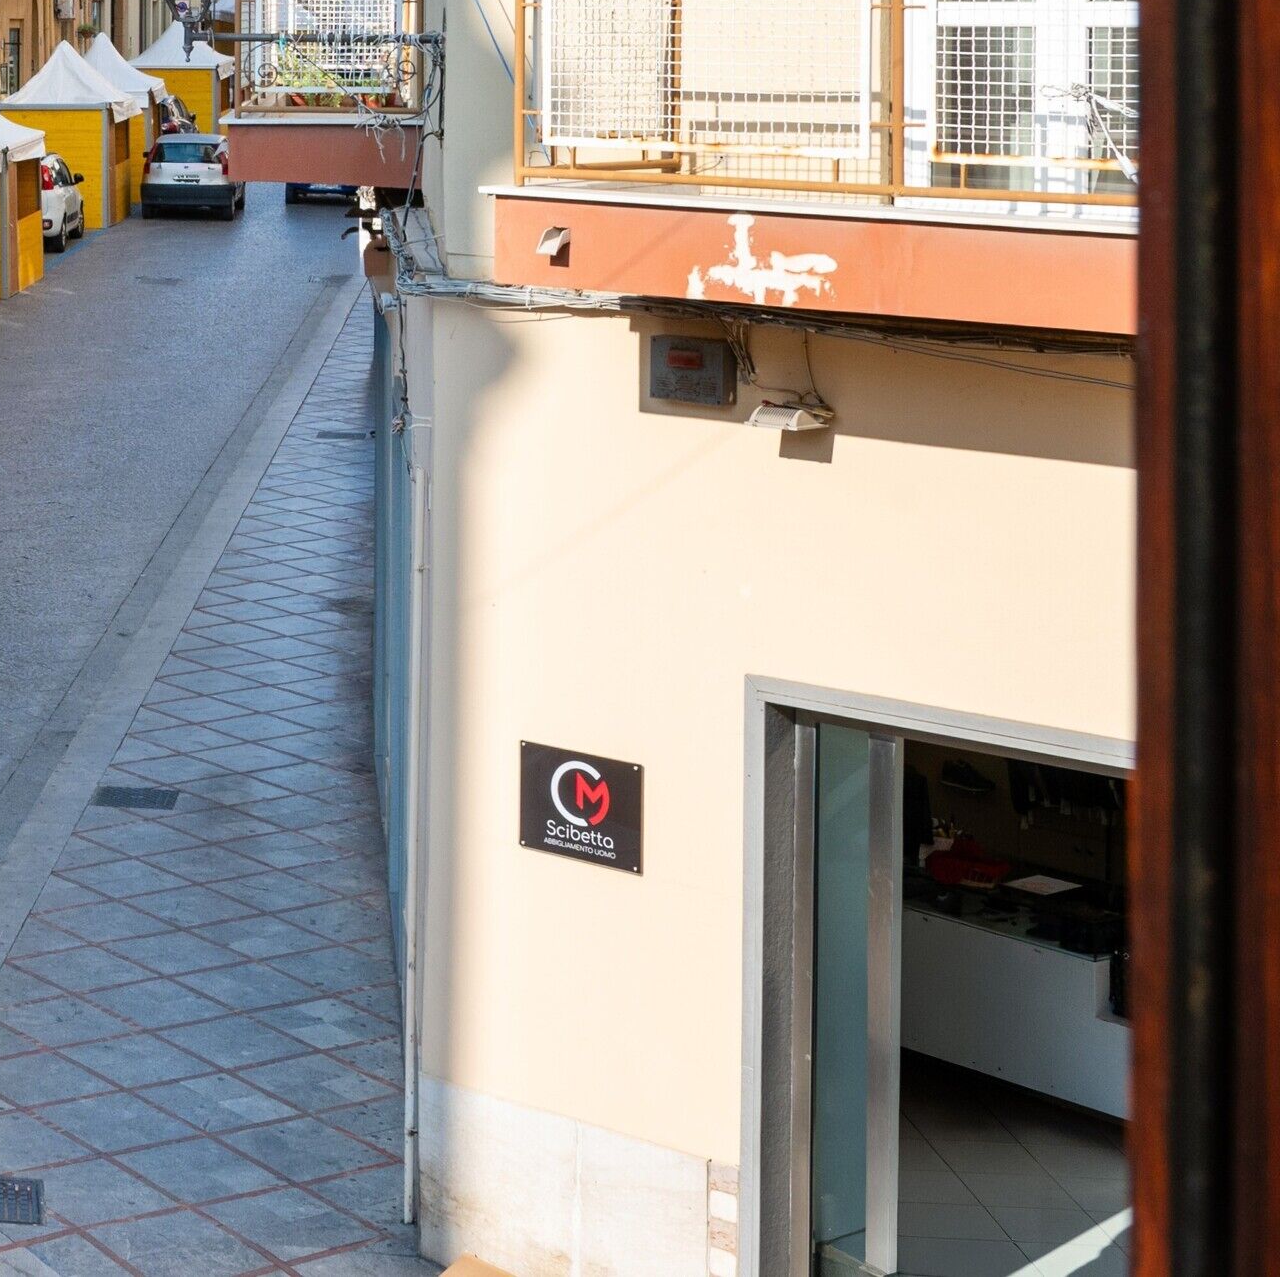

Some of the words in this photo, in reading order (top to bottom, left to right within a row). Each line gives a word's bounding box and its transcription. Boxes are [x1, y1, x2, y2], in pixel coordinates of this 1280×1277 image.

[546, 819, 614, 849] Scibetta
[544, 837, 594, 854] ABBIGLIAMENTO
[594, 848, 616, 860] UOMO
